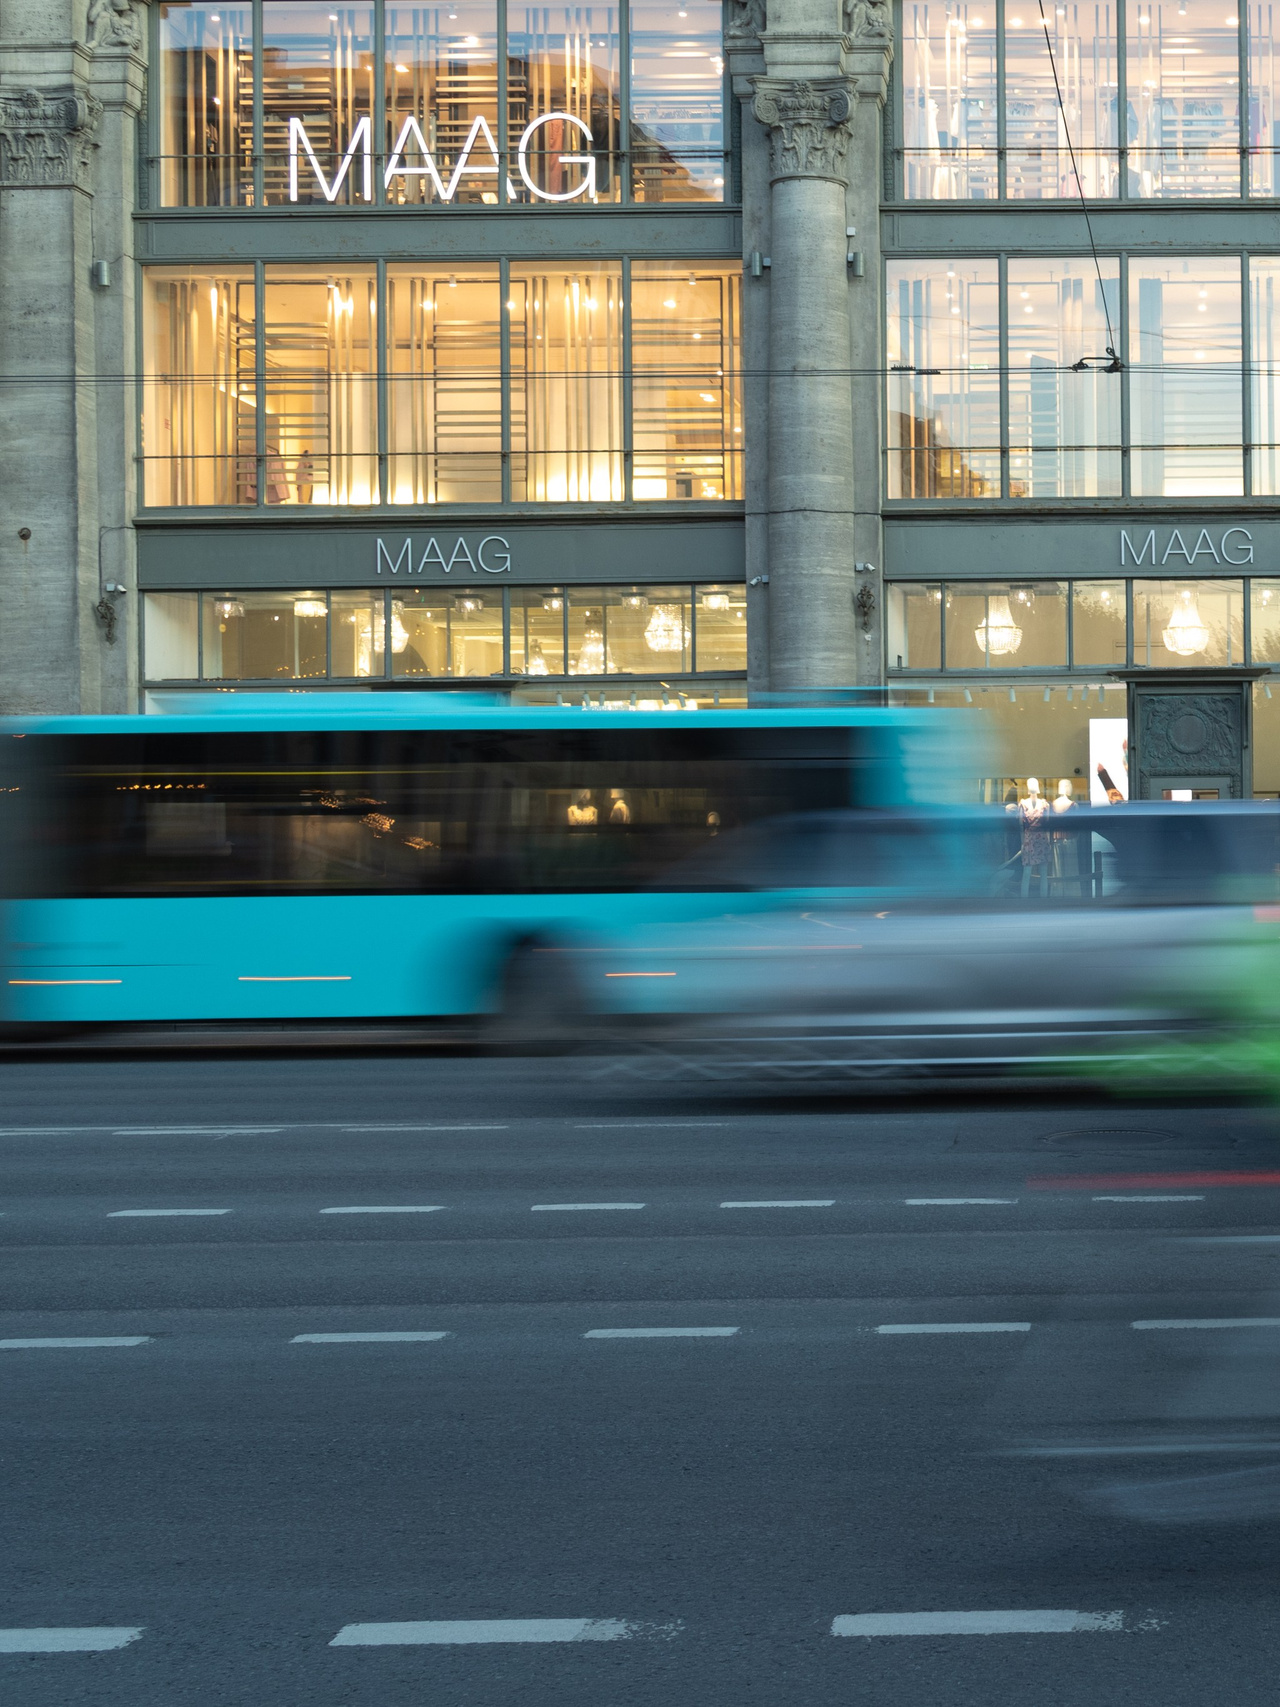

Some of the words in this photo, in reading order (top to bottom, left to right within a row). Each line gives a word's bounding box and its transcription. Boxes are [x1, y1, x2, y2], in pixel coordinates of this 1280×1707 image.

[289, 112, 596, 202] MAAG
[376, 535, 511, 574] MAAG
[1120, 527, 1254, 565] MAAG
